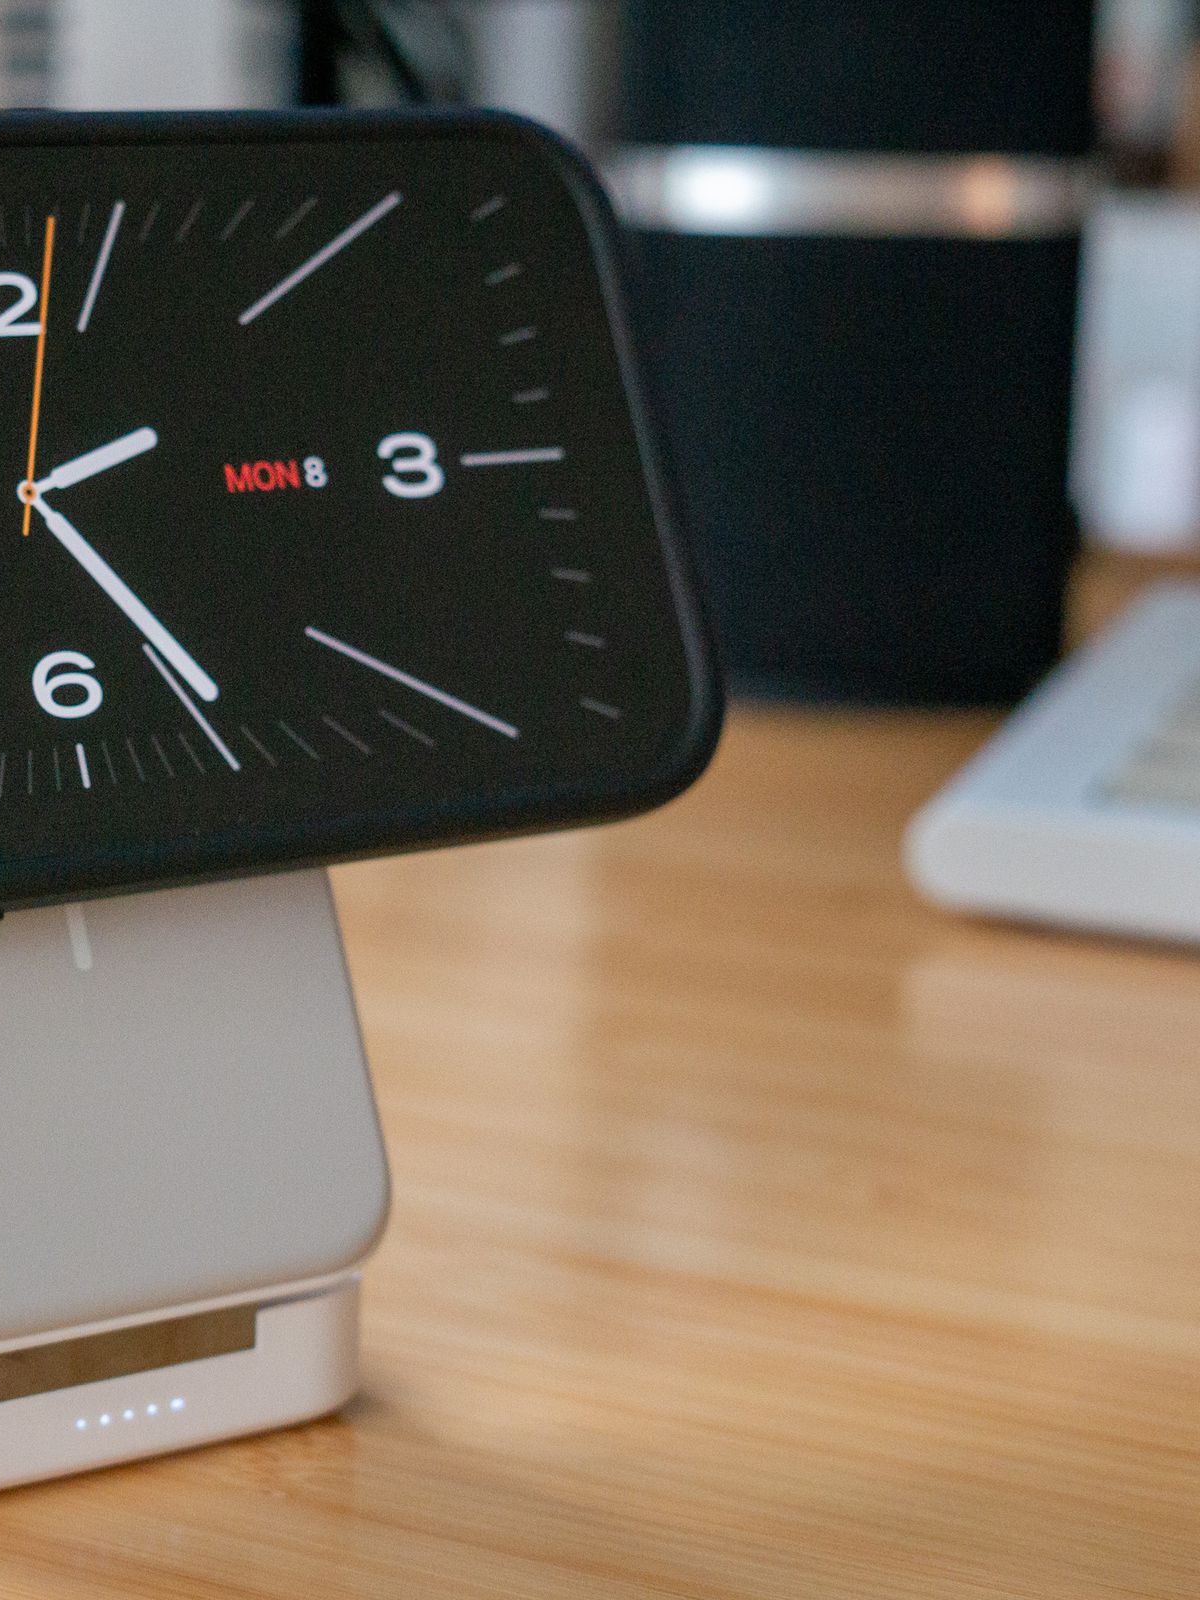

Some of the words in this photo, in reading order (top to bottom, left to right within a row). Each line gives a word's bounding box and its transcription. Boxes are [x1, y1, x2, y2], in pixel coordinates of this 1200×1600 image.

[224, 460, 301, 493] MON
[303, 456, 328, 489] 8
[377, 433, 443, 498] 3
[32, 651, 103, 719] 6
